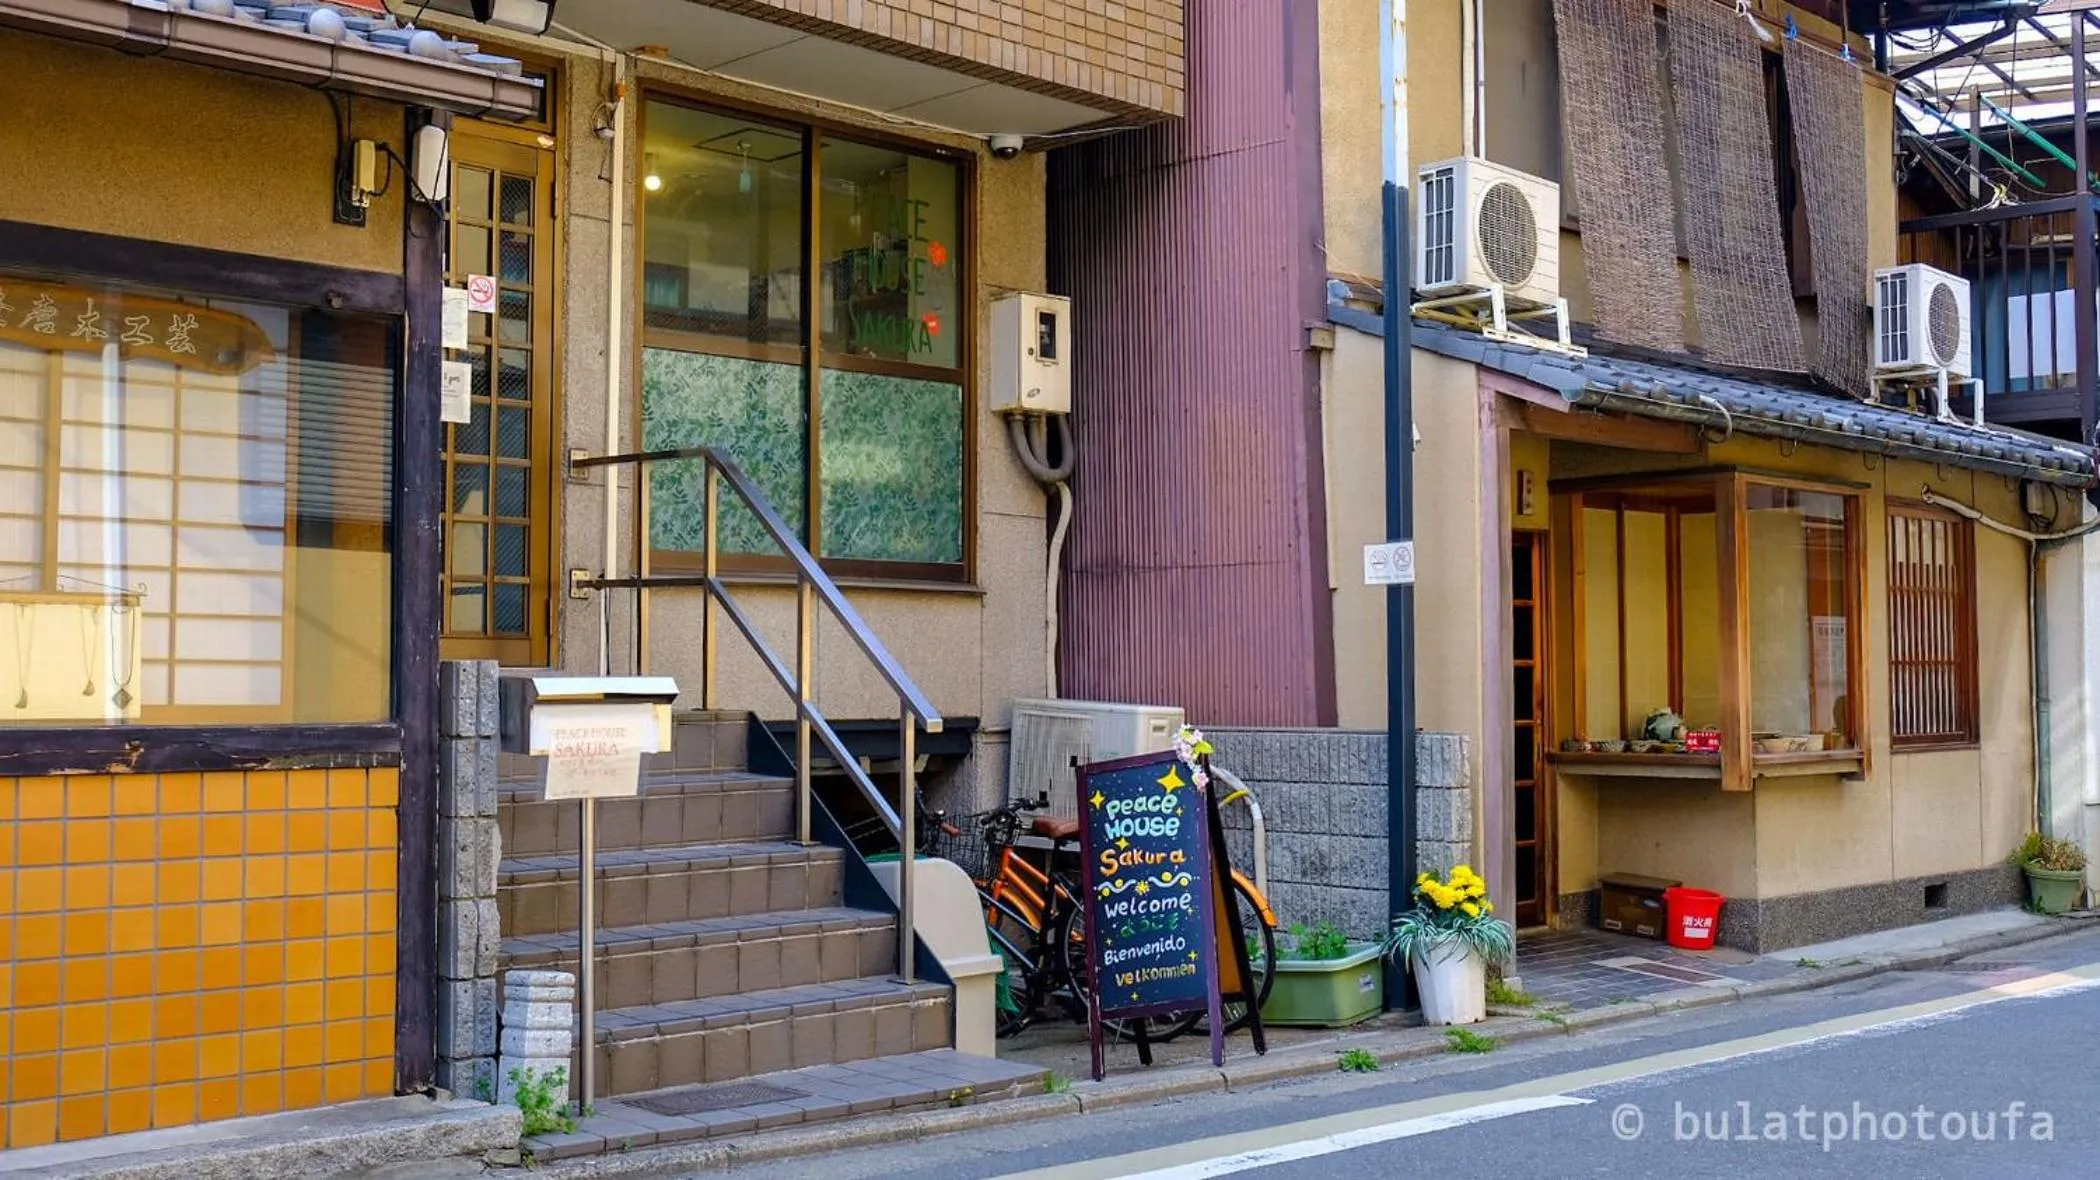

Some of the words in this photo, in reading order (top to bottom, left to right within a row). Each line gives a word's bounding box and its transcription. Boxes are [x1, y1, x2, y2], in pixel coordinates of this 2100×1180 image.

[553, 742, 619, 758] SAKURA
[1100, 848, 1187, 876] Sakura
[1104, 935, 1186, 966] Bienvenido
